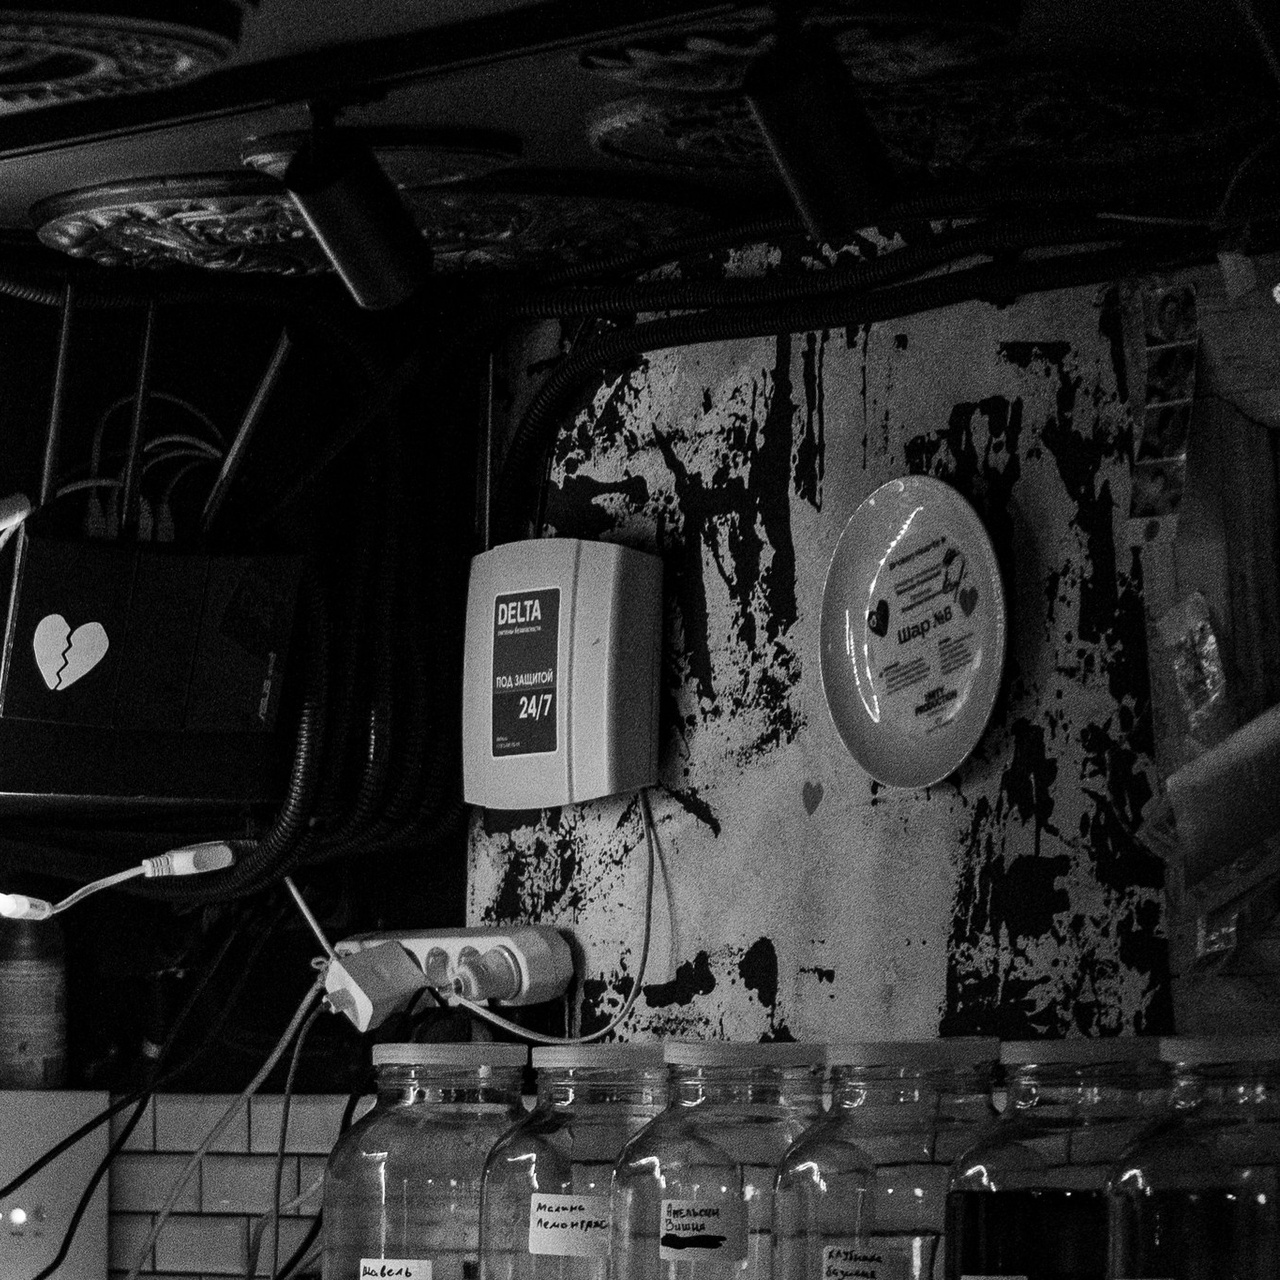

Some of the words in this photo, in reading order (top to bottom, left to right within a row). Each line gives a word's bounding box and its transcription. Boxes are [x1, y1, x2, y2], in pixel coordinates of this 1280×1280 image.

[497, 599, 542, 625] DELTA
[897, 619, 931, 644] Шар
[496, 676, 514, 689] ПОД
[514, 668, 554, 686] ЗАЩИТОЙ
[519, 694, 553, 721] 24/7
